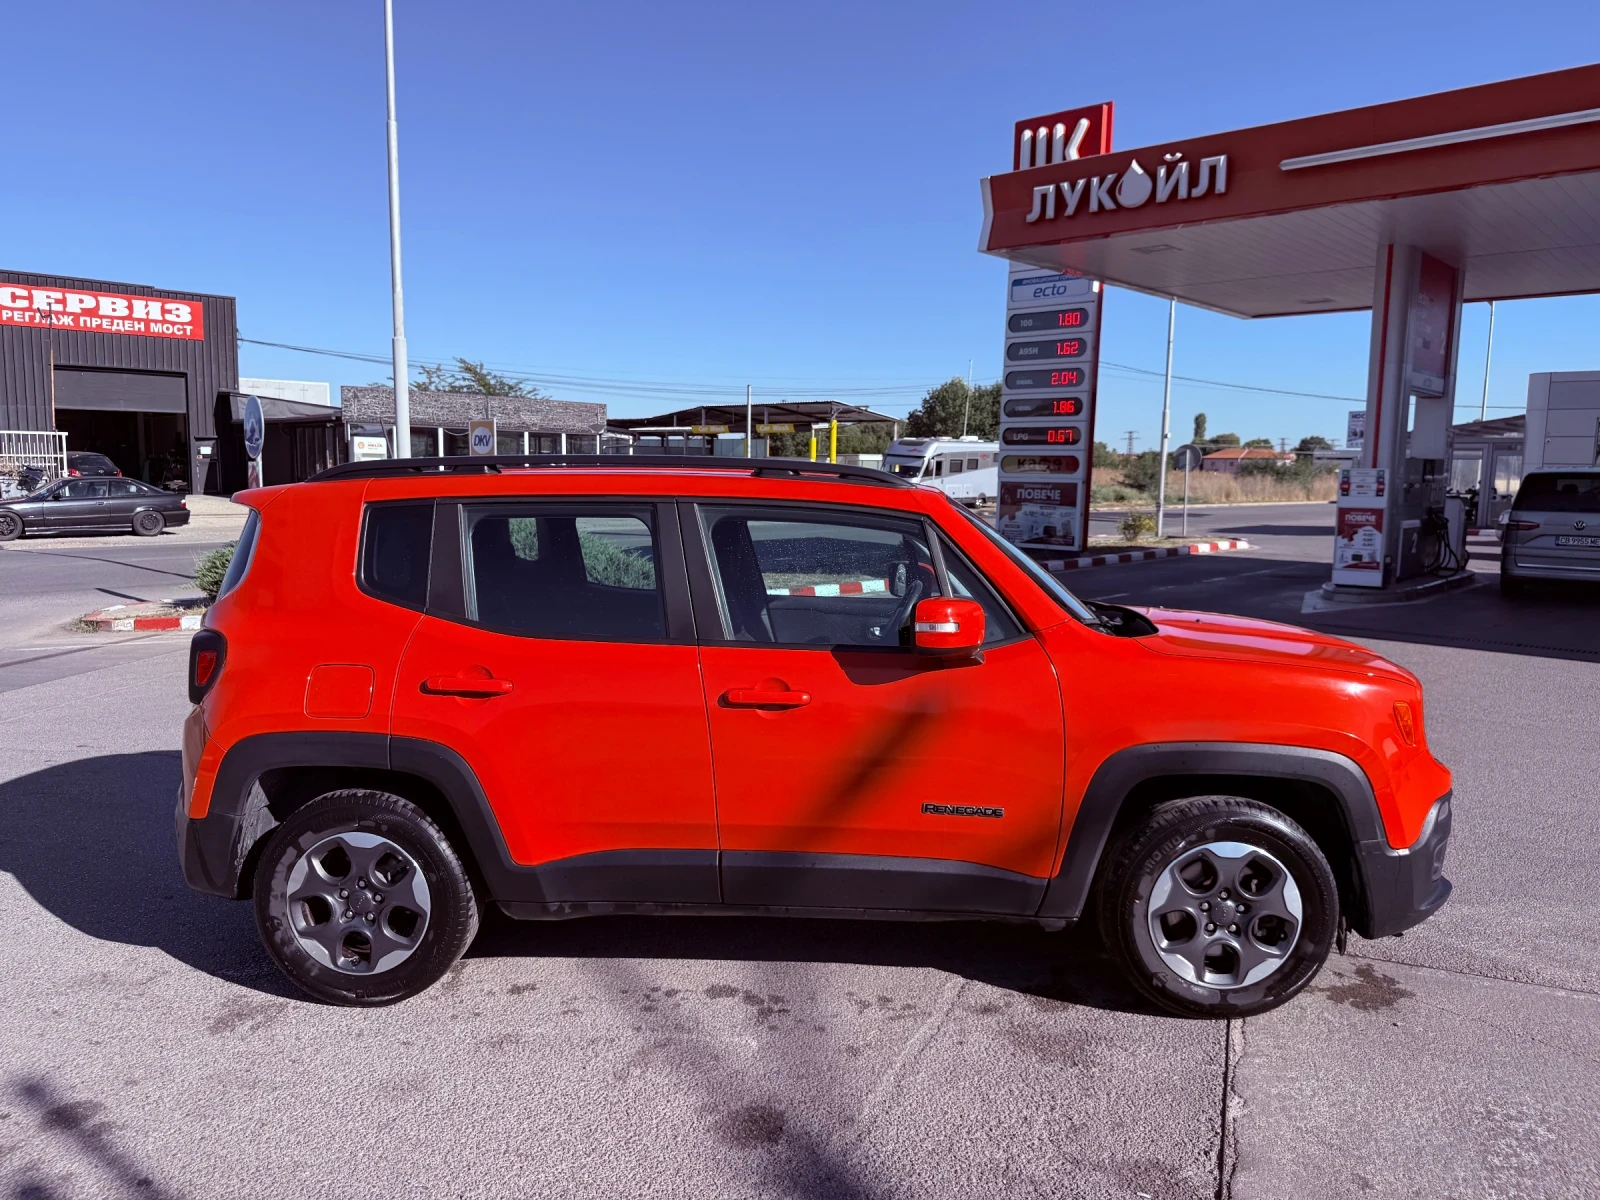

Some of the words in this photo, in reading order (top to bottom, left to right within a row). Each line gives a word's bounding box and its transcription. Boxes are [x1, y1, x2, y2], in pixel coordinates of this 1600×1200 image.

[1033, 283, 1067, 298] ecto
[0, 287, 192, 322] СЕРВИЗ
[2, 309, 74, 327] РЕГЛАЖ
[79, 316, 145, 332] ПРЕДЕН
[150, 323, 193, 336] МОСТ
[1058, 312, 1081, 326] 1.80
[1056, 341, 1079, 355] 1.62
[1051, 371, 1077, 385] 2.04
[473, 434, 491, 447] DKV
[1047, 430, 1073, 443] 0.67
[1016, 488, 1061, 500] ПОВЕЧЕ
[922, 802, 1004, 818] RENEGADE
